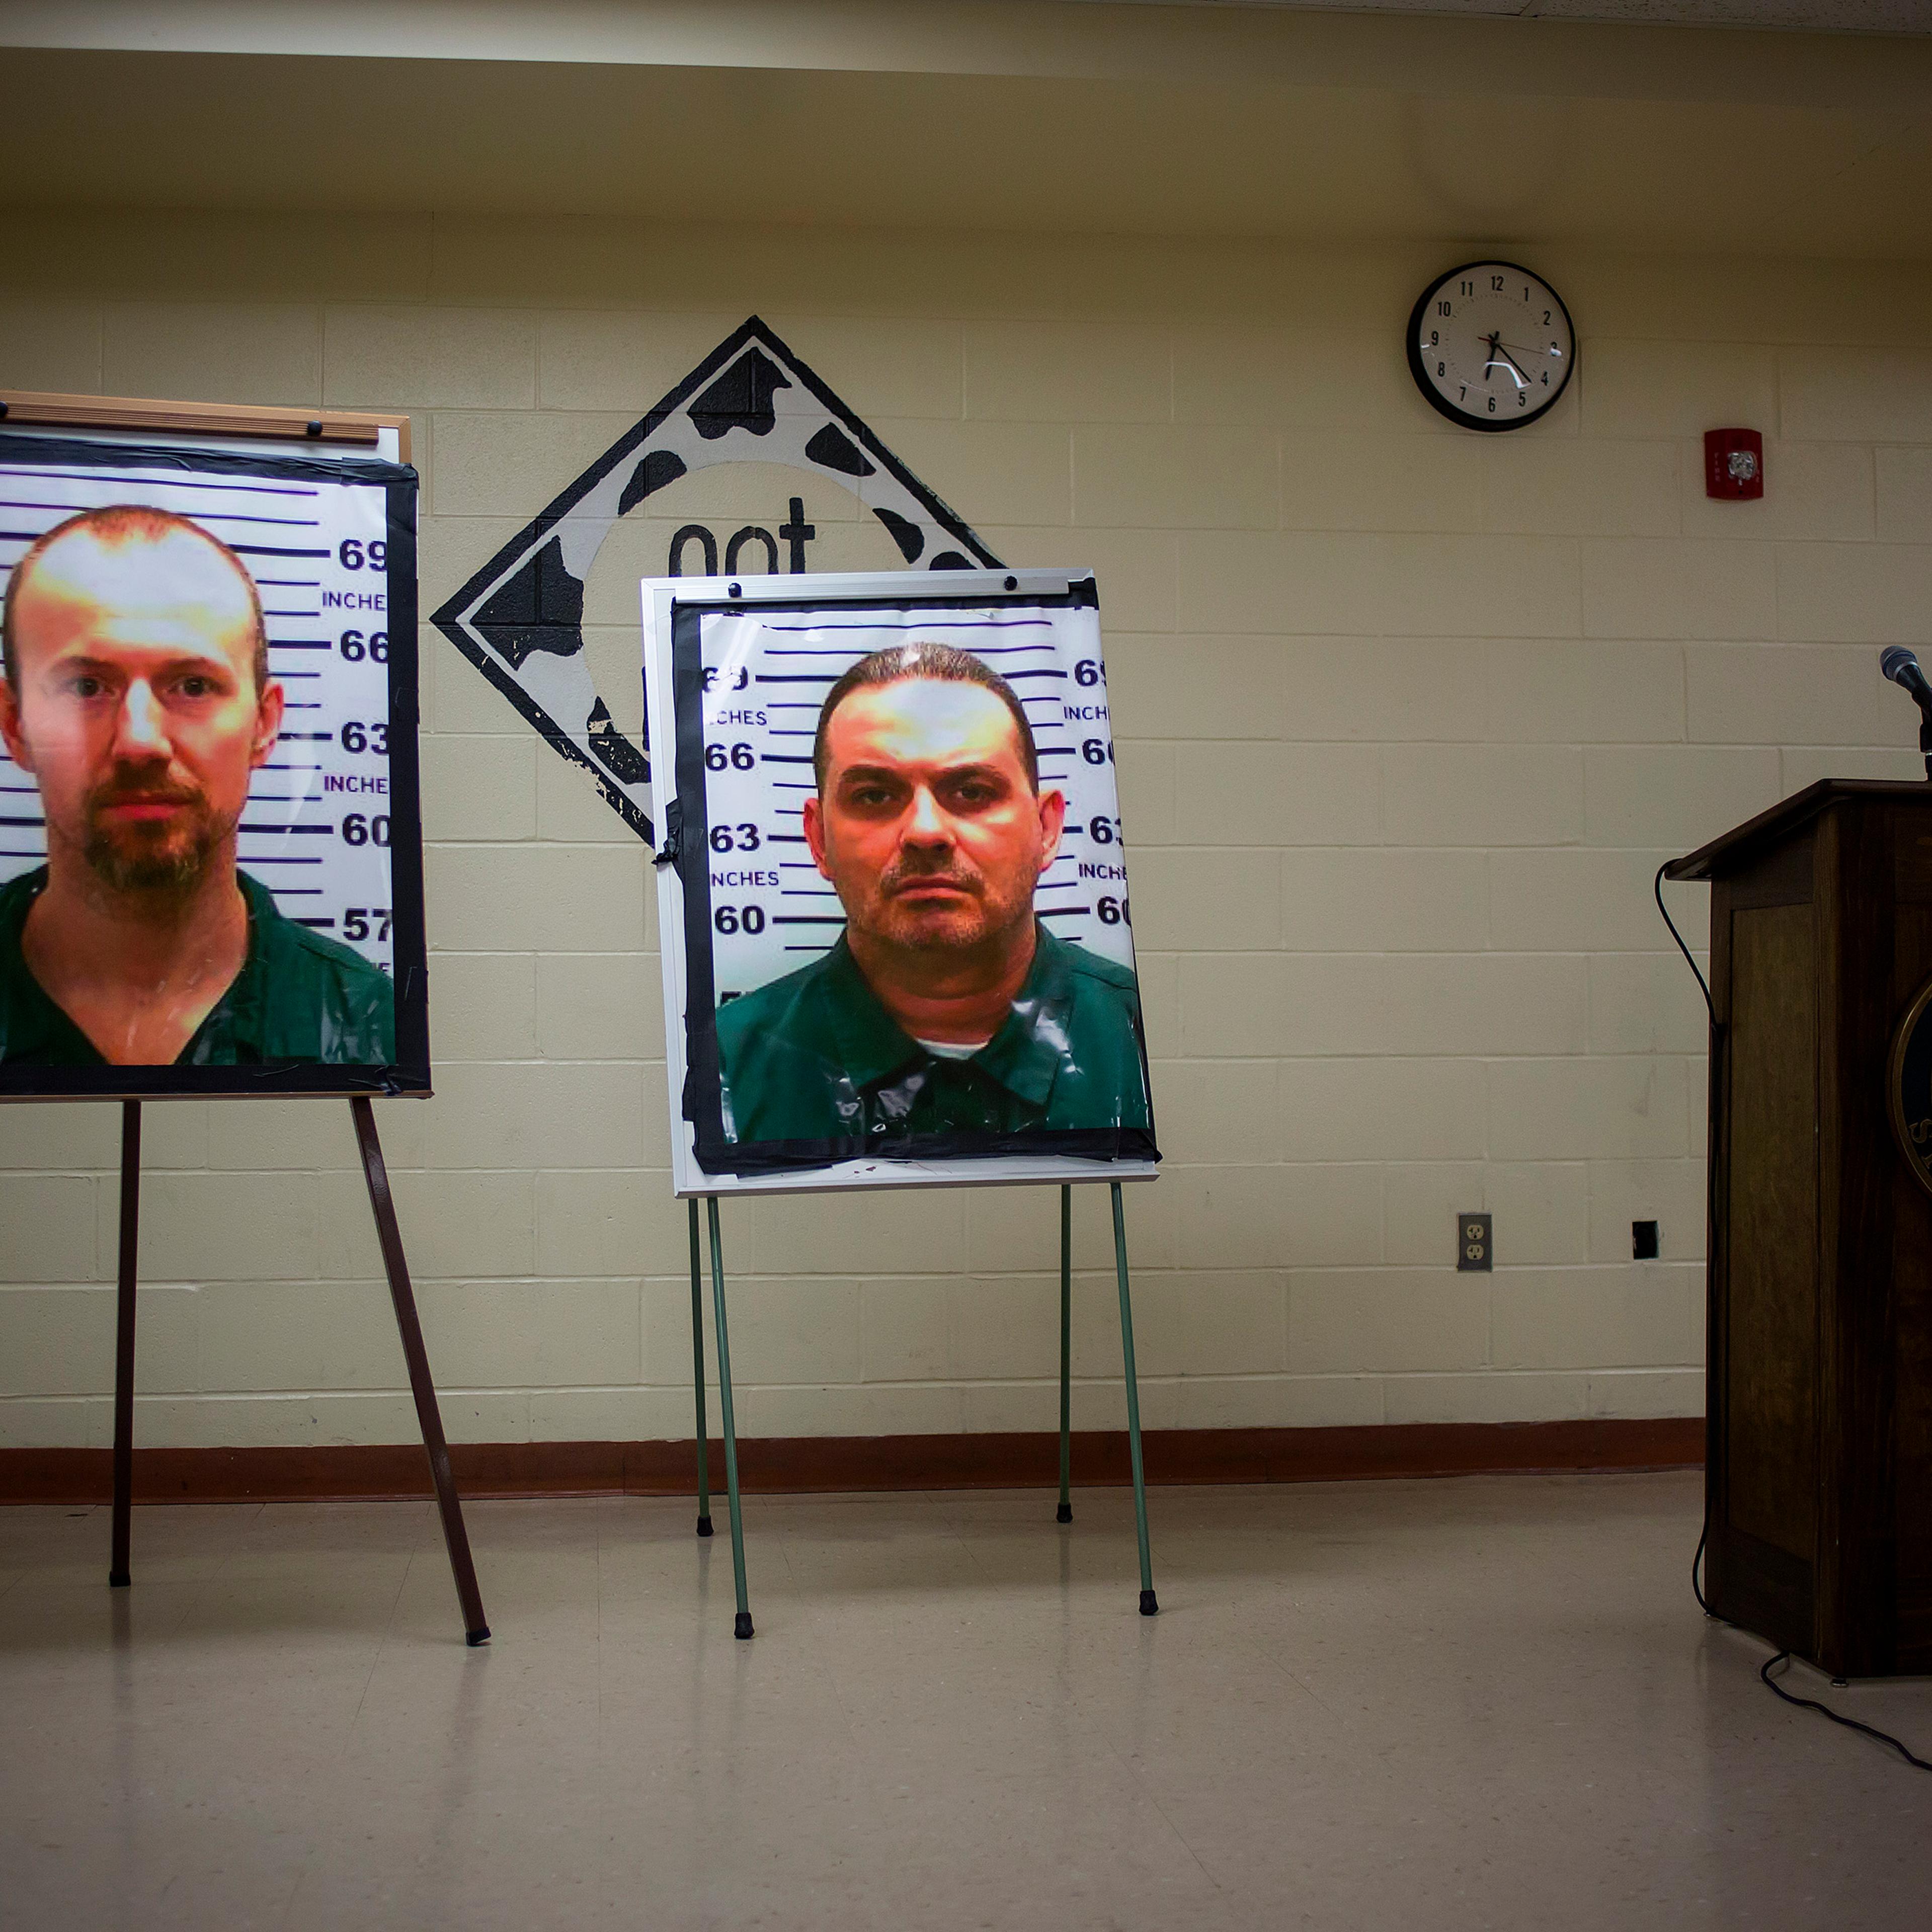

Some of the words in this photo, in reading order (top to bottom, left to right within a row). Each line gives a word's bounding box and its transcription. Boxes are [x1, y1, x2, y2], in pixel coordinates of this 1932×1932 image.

[1461, 281, 1473, 296] 11
[1491, 276, 1504, 291] 12
[1524, 287, 1529, 301] 1
[1438, 302, 1451, 317] 10
[1544, 311, 1551, 326] 2
[1431, 331, 1439, 346] 9
[1438, 362, 1445, 377] 8
[1541, 371, 1548, 386] 4
[1460, 386, 1467, 401] 7
[1518, 392, 1526, 407] 5
[1489, 397, 1496, 412] 6
[340, 539, 387, 572] 69
[322, 591, 386, 611] INCHE
[1074, 660, 1106, 686] 6
[341, 721, 389, 754] 63
[705, 742, 755, 771] 66
[1082, 739, 1115, 766] 6
[324, 776, 389, 794] INCHE
[710, 824, 760, 853] 63
[711, 872, 779, 887] NCHES
[343, 908, 392, 941] 57
[715, 906, 765, 935] 60
